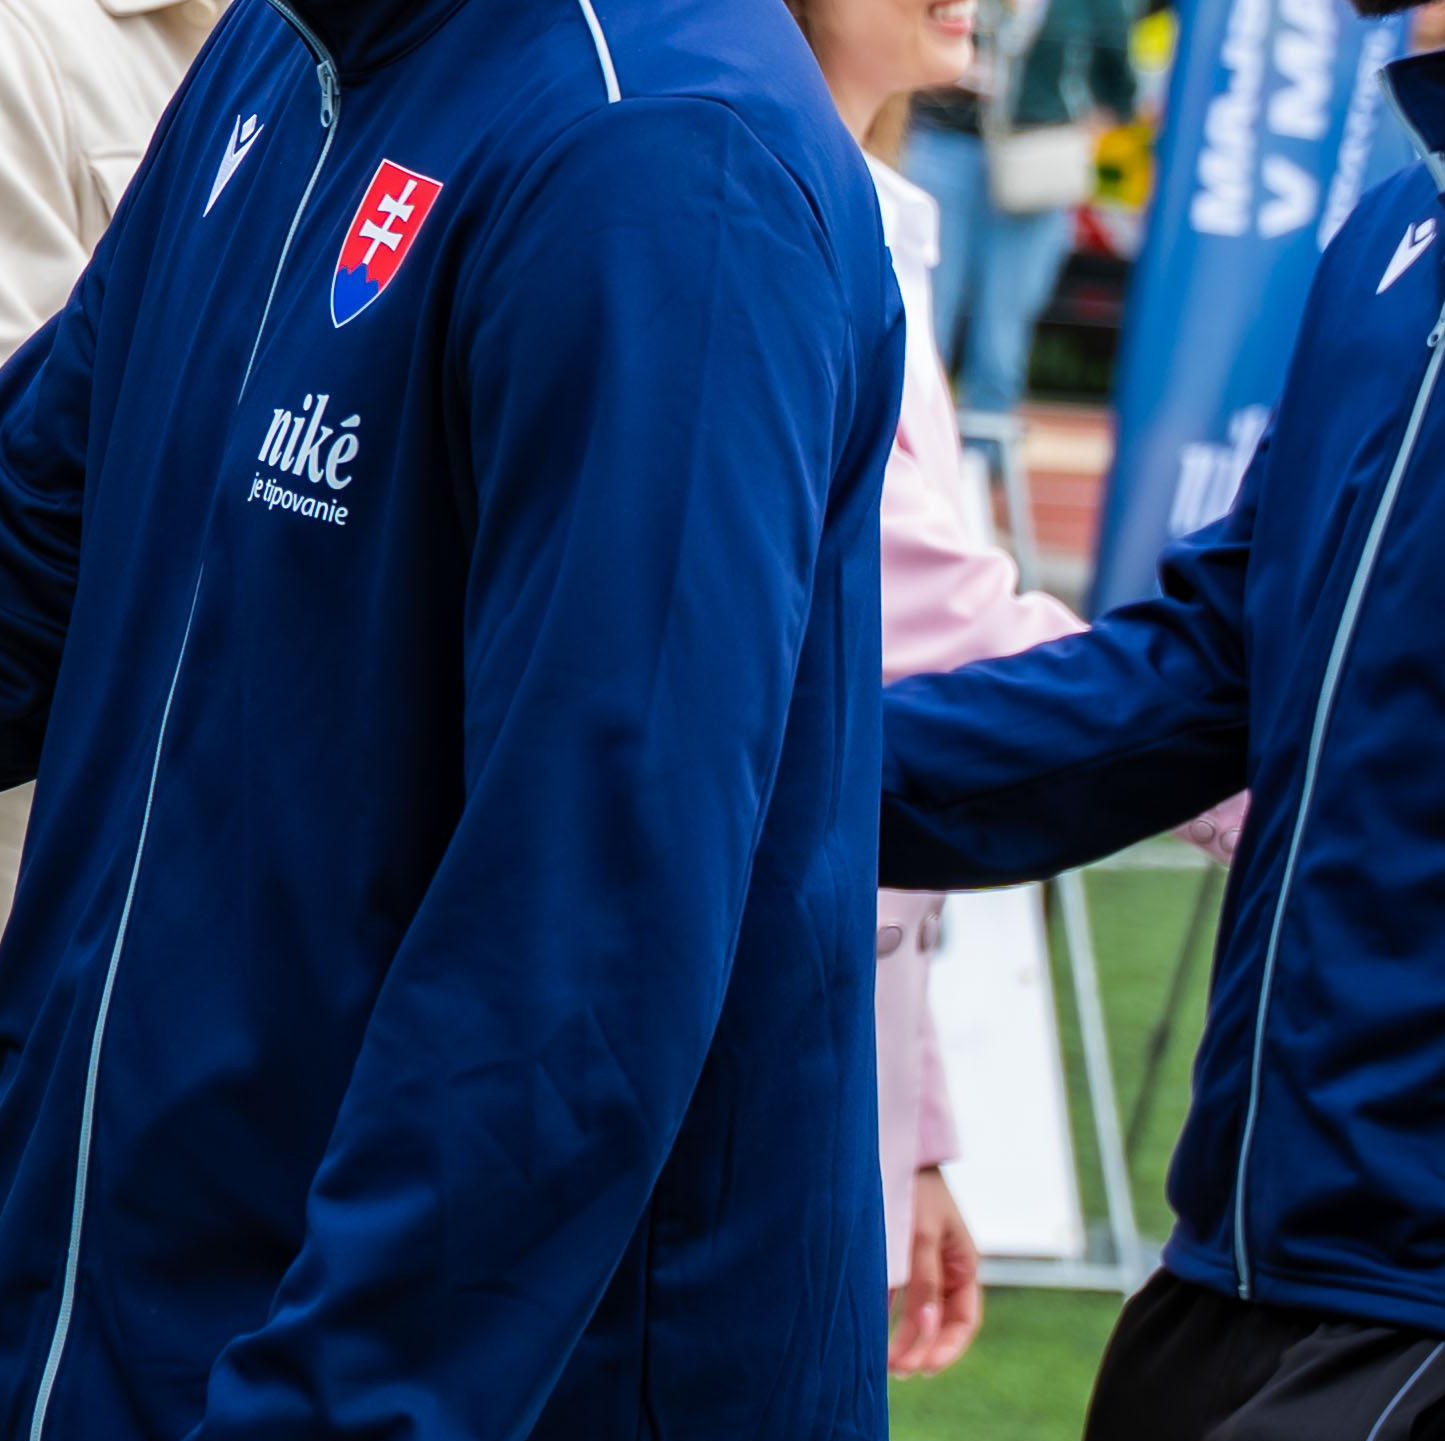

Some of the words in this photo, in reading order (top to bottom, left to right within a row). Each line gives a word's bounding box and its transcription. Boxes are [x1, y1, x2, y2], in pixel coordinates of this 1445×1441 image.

[1257, 153, 1319, 240] V
[257, 393, 361, 490] niké
[262, 478, 349, 526] tipovanie
